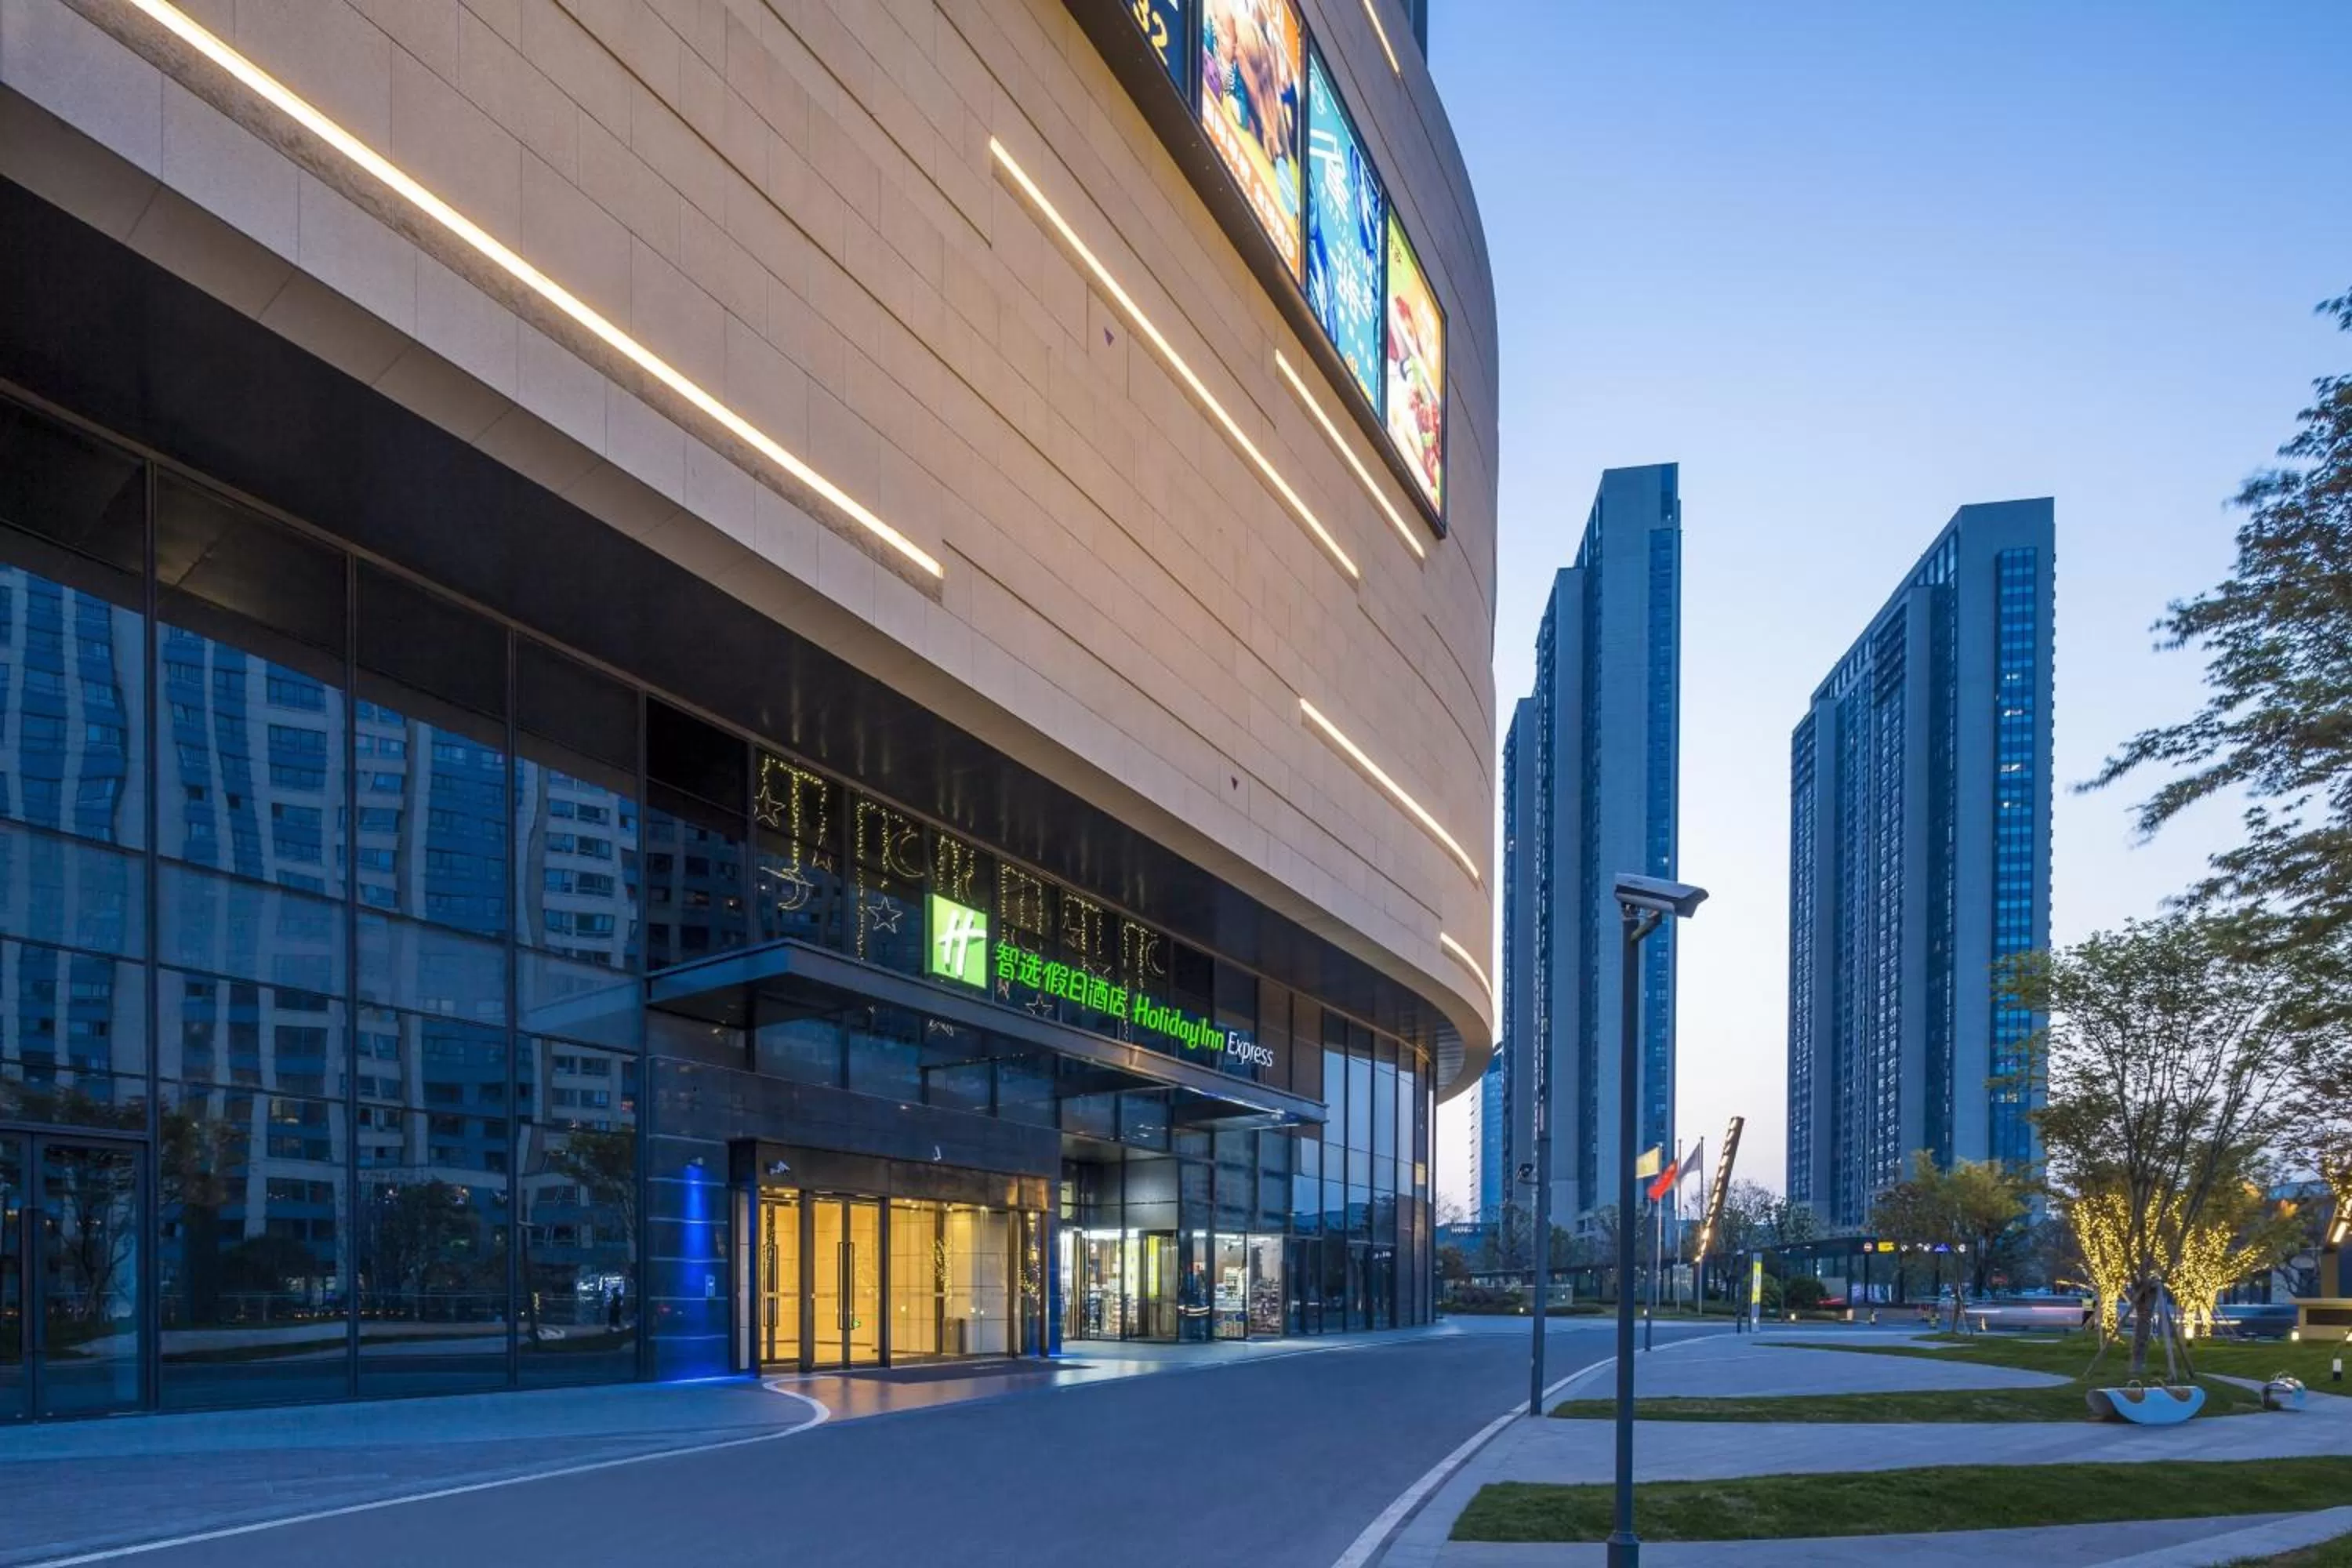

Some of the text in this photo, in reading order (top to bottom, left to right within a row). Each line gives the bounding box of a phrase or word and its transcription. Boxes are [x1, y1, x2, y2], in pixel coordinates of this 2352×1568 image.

[995, 942, 1128, 1018] 智选假日酒店
[1227, 1031, 1274, 1067] Express
